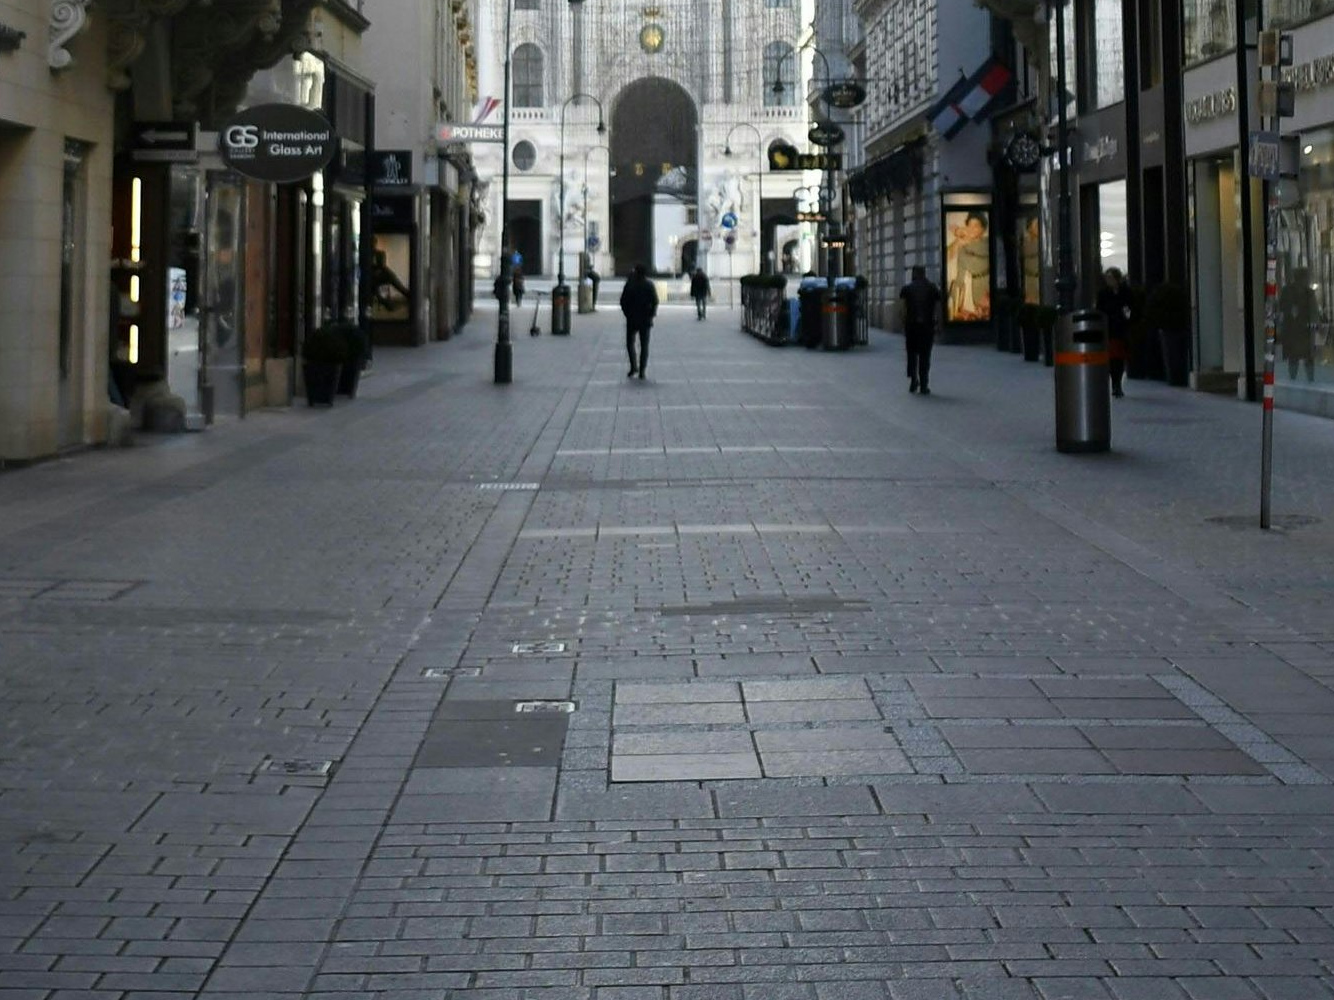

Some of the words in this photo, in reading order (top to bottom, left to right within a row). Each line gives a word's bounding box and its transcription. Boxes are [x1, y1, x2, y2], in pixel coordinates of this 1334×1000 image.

[226, 125, 259, 148] GS
[263, 130, 330, 141] International
[270, 144, 303, 156] Glass
[303, 144, 323, 156] Art
